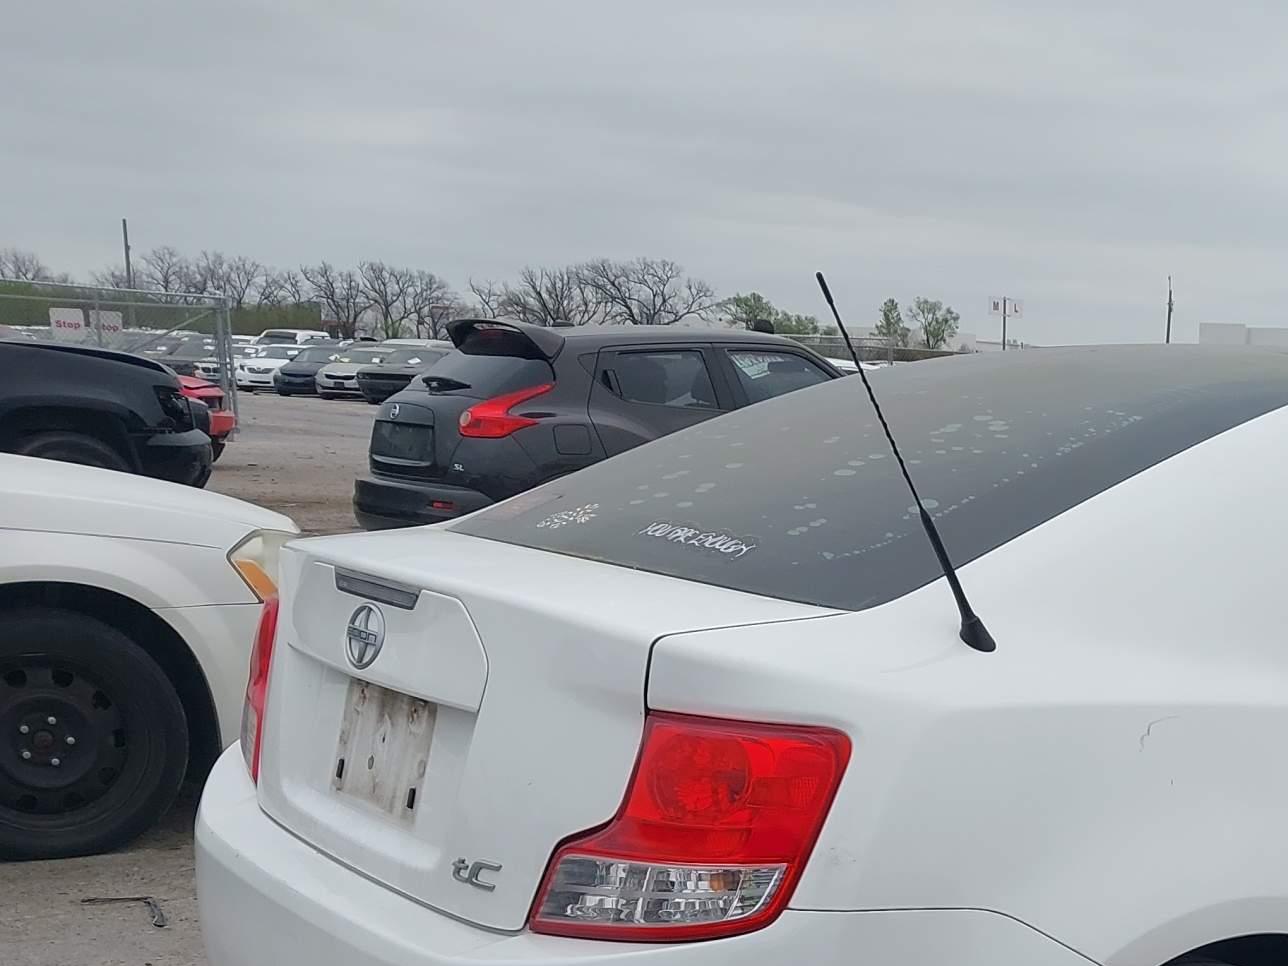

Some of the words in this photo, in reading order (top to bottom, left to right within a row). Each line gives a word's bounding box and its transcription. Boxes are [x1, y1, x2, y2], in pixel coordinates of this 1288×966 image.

[55, 320, 81, 330] Stop
[99, 322, 119, 332] top
[451, 857, 503, 892] tC
